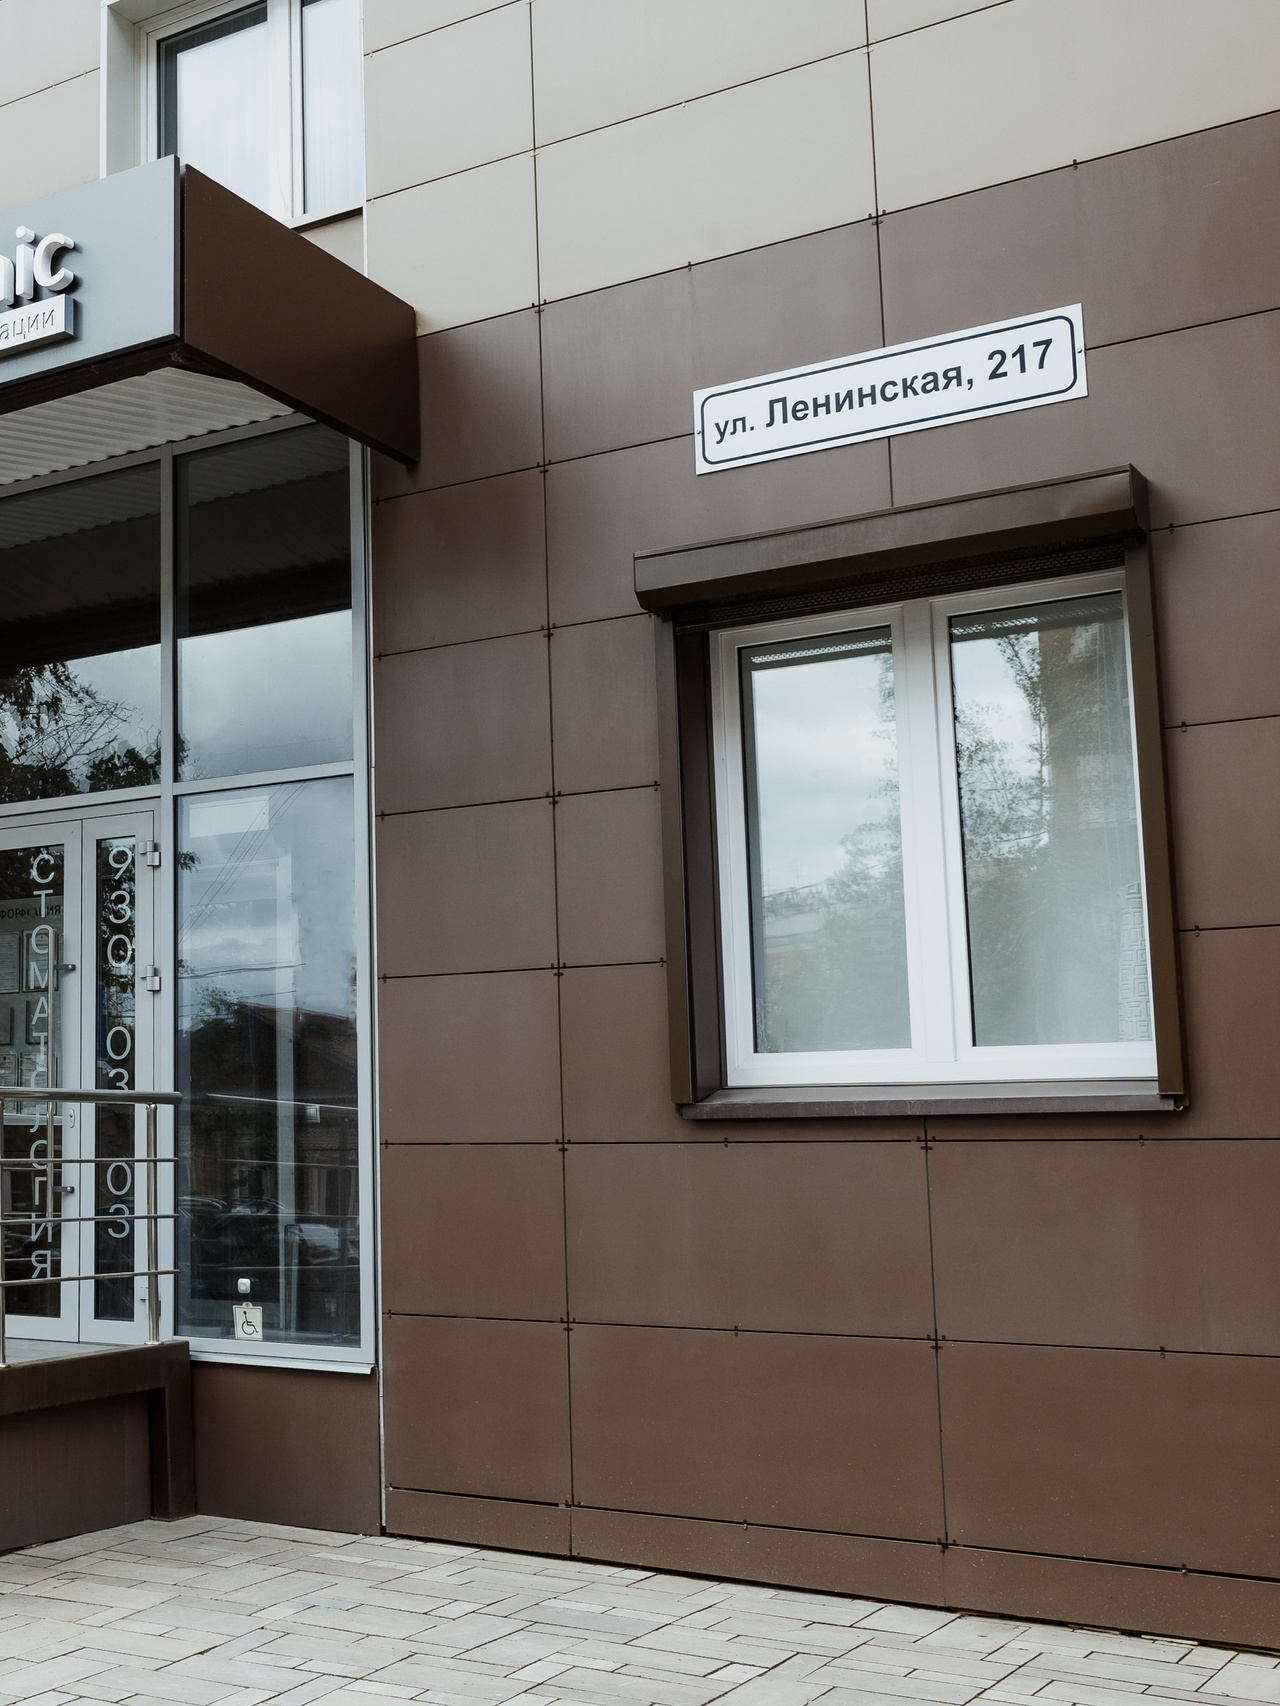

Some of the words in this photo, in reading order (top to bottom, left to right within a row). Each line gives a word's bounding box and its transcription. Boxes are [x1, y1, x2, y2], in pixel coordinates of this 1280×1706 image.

[714, 415, 755, 445] ул.
[765, 366, 974, 428] Ленинская,
[987, 338, 1054, 381] 217
[107, 846, 132, 968] 930
[106, 1026, 131, 1091] 03
[106, 1161, 131, 1238] 03
